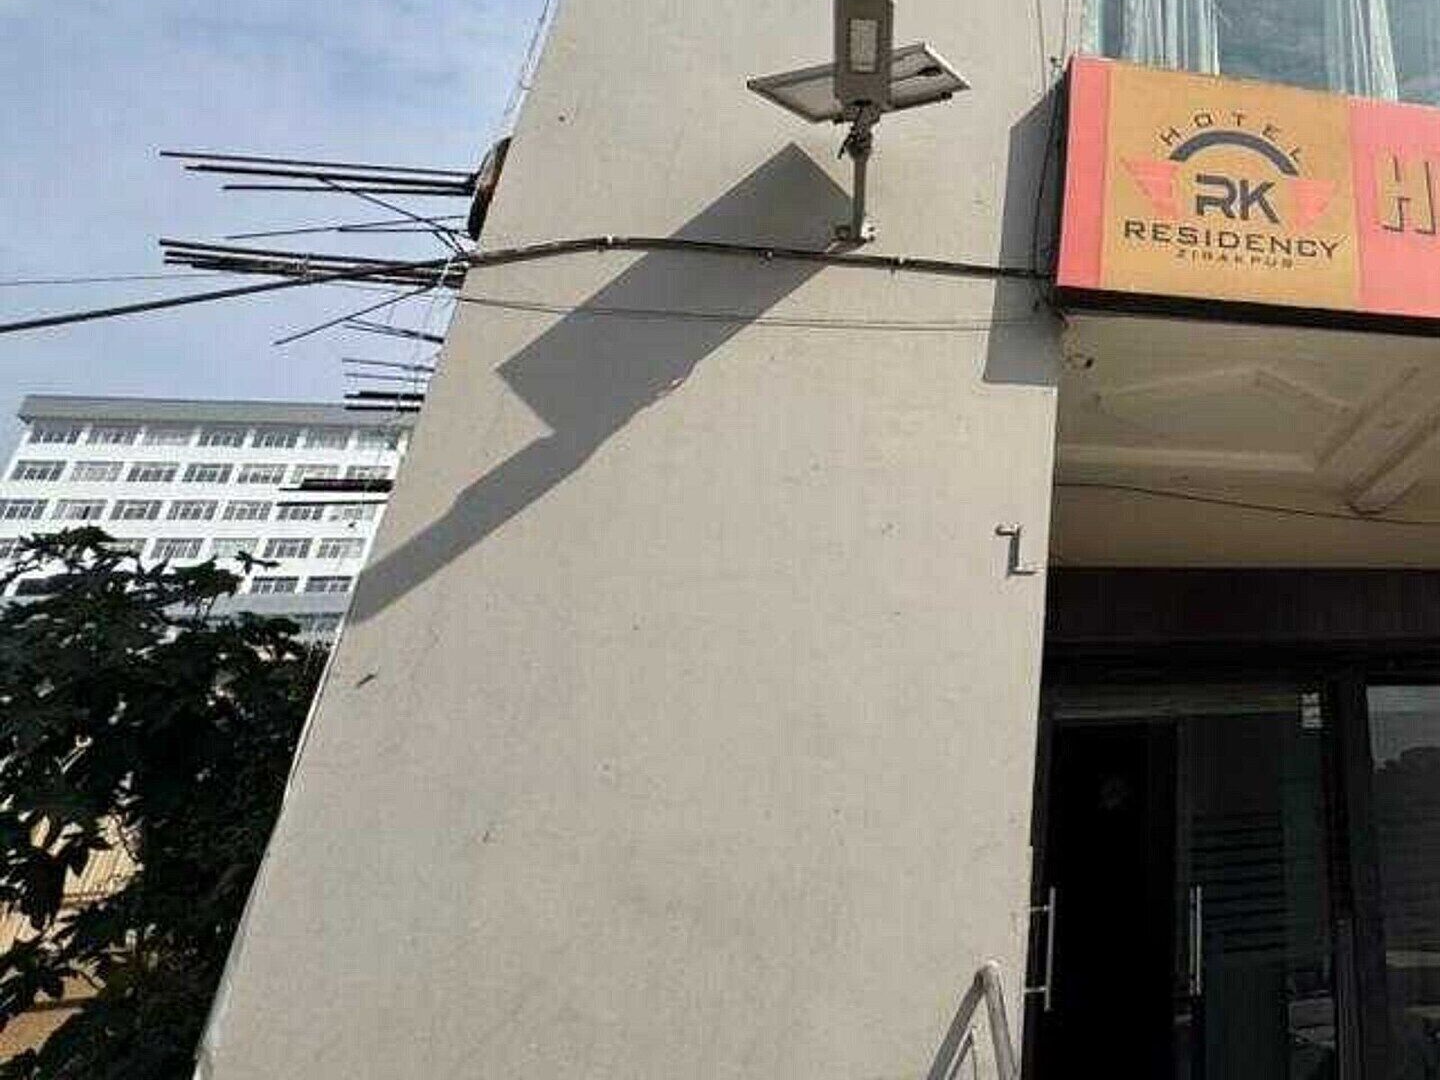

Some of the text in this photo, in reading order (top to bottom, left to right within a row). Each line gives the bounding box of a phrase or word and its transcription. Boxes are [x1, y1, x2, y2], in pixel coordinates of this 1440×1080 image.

[1160, 111, 1301, 163] HOTEL
[1196, 173, 1280, 224] RK
[1124, 220, 1338, 258] RESIDENCY
